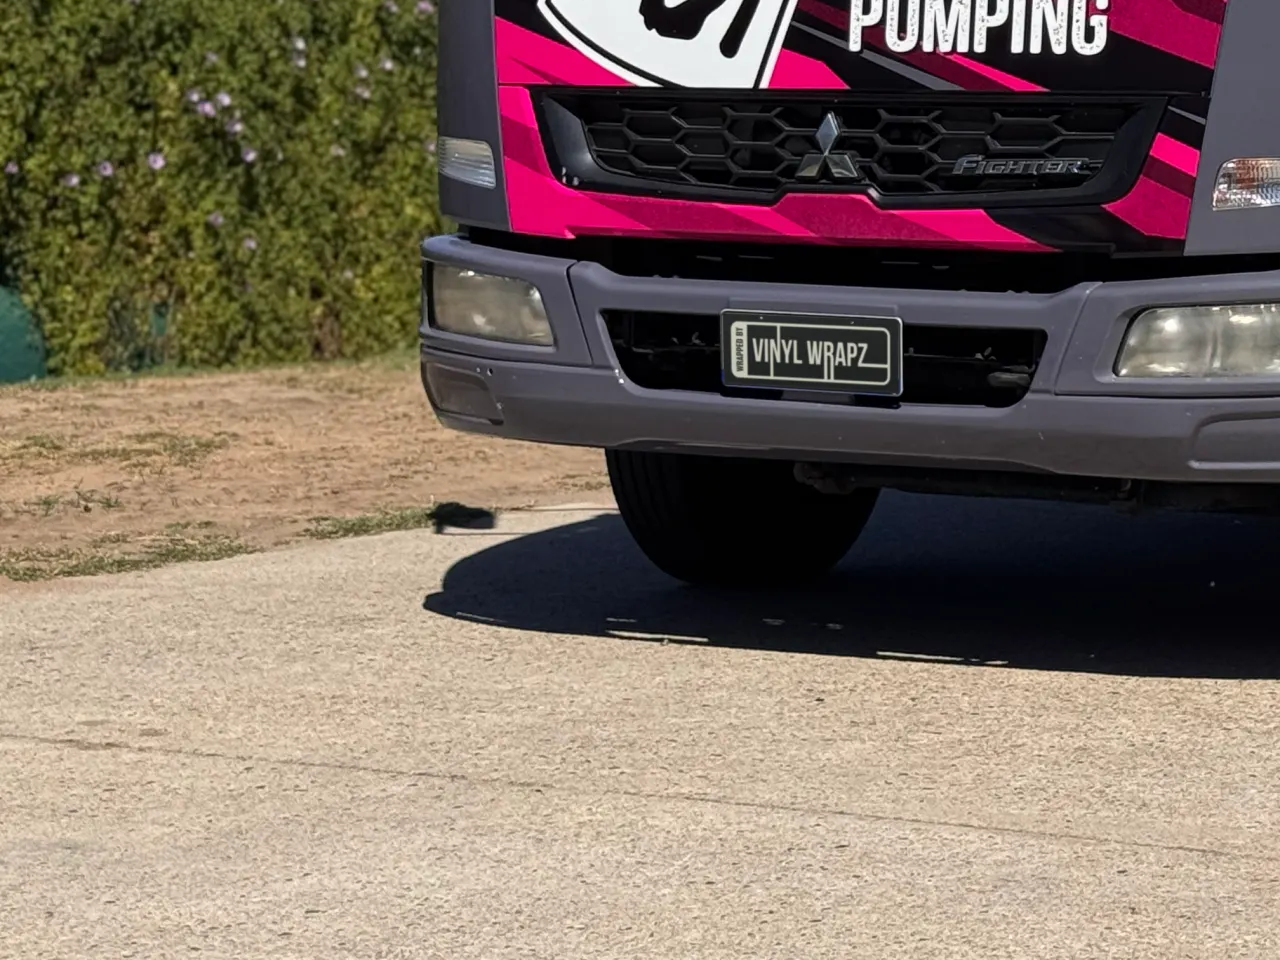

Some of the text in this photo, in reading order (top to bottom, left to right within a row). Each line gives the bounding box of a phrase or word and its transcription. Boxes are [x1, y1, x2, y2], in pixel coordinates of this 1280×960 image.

[735, 327, 744, 372] WRAPPED BY
[752, 335, 870, 373] VINYL WRAPZ
